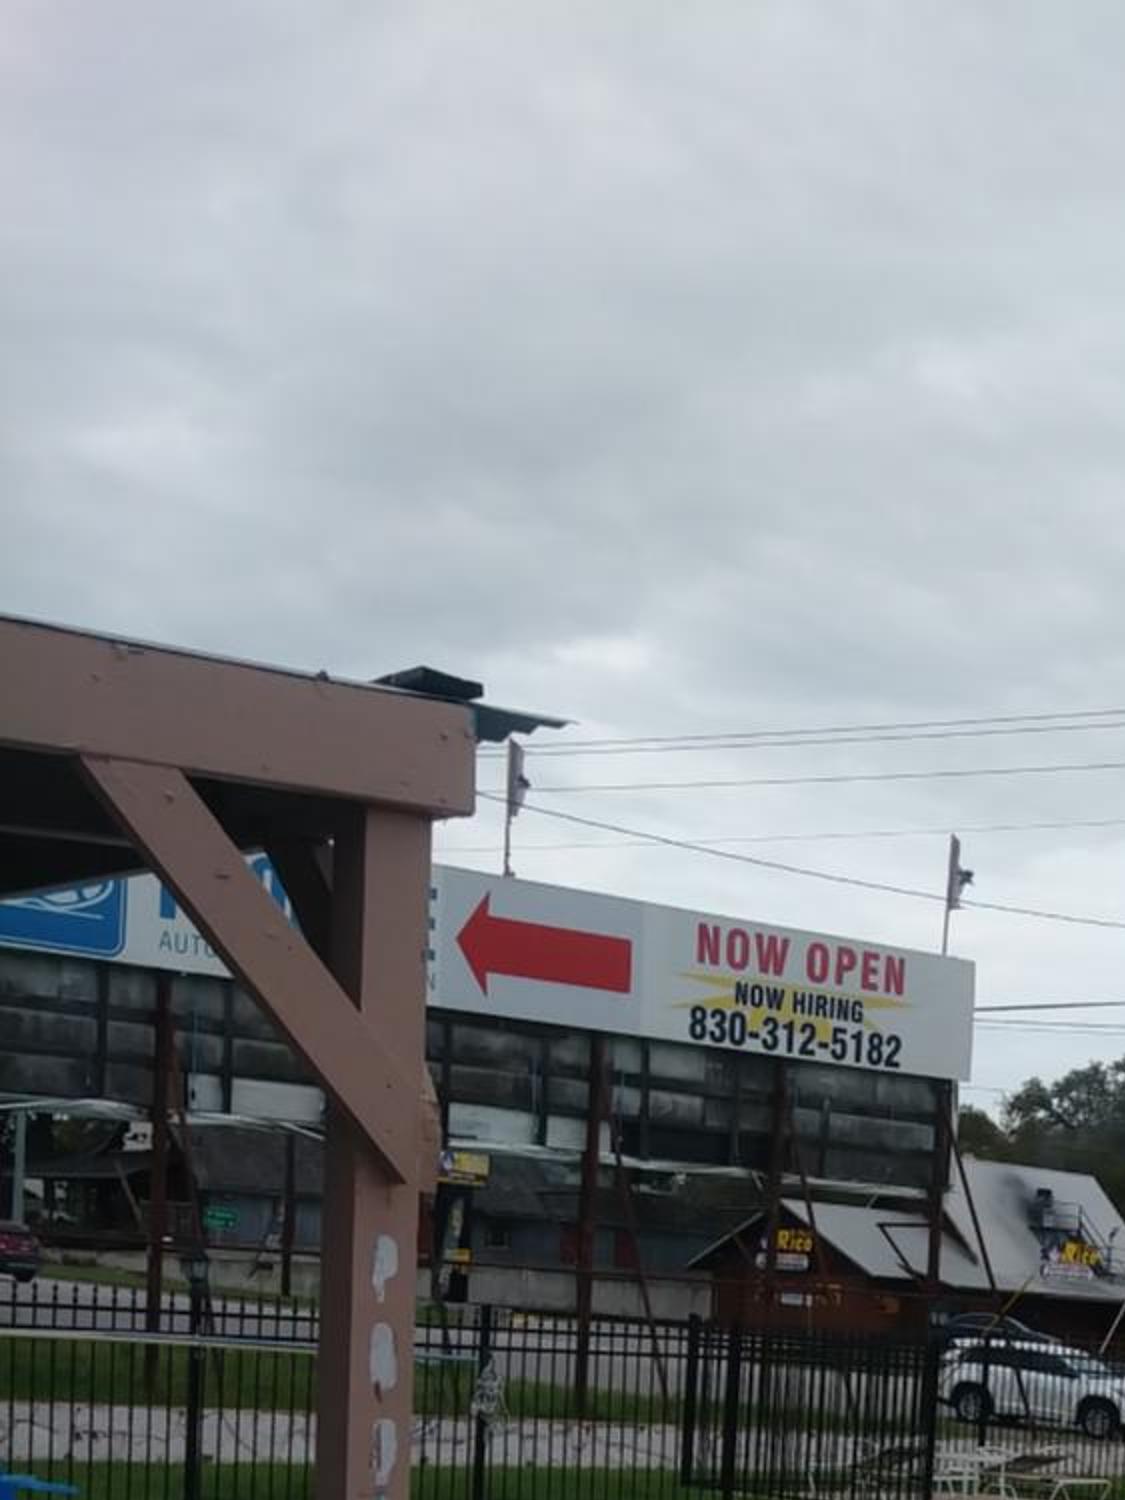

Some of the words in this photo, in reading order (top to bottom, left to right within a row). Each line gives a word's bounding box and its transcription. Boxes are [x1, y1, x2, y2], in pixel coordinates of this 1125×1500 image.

[697, 922, 790, 977] NOW
[806, 940, 906, 996] OPEN
[735, 981, 785, 1011] NOW
[793, 991, 864, 1024] HIRING
[690, 1005, 902, 1068] 830-312-5182
